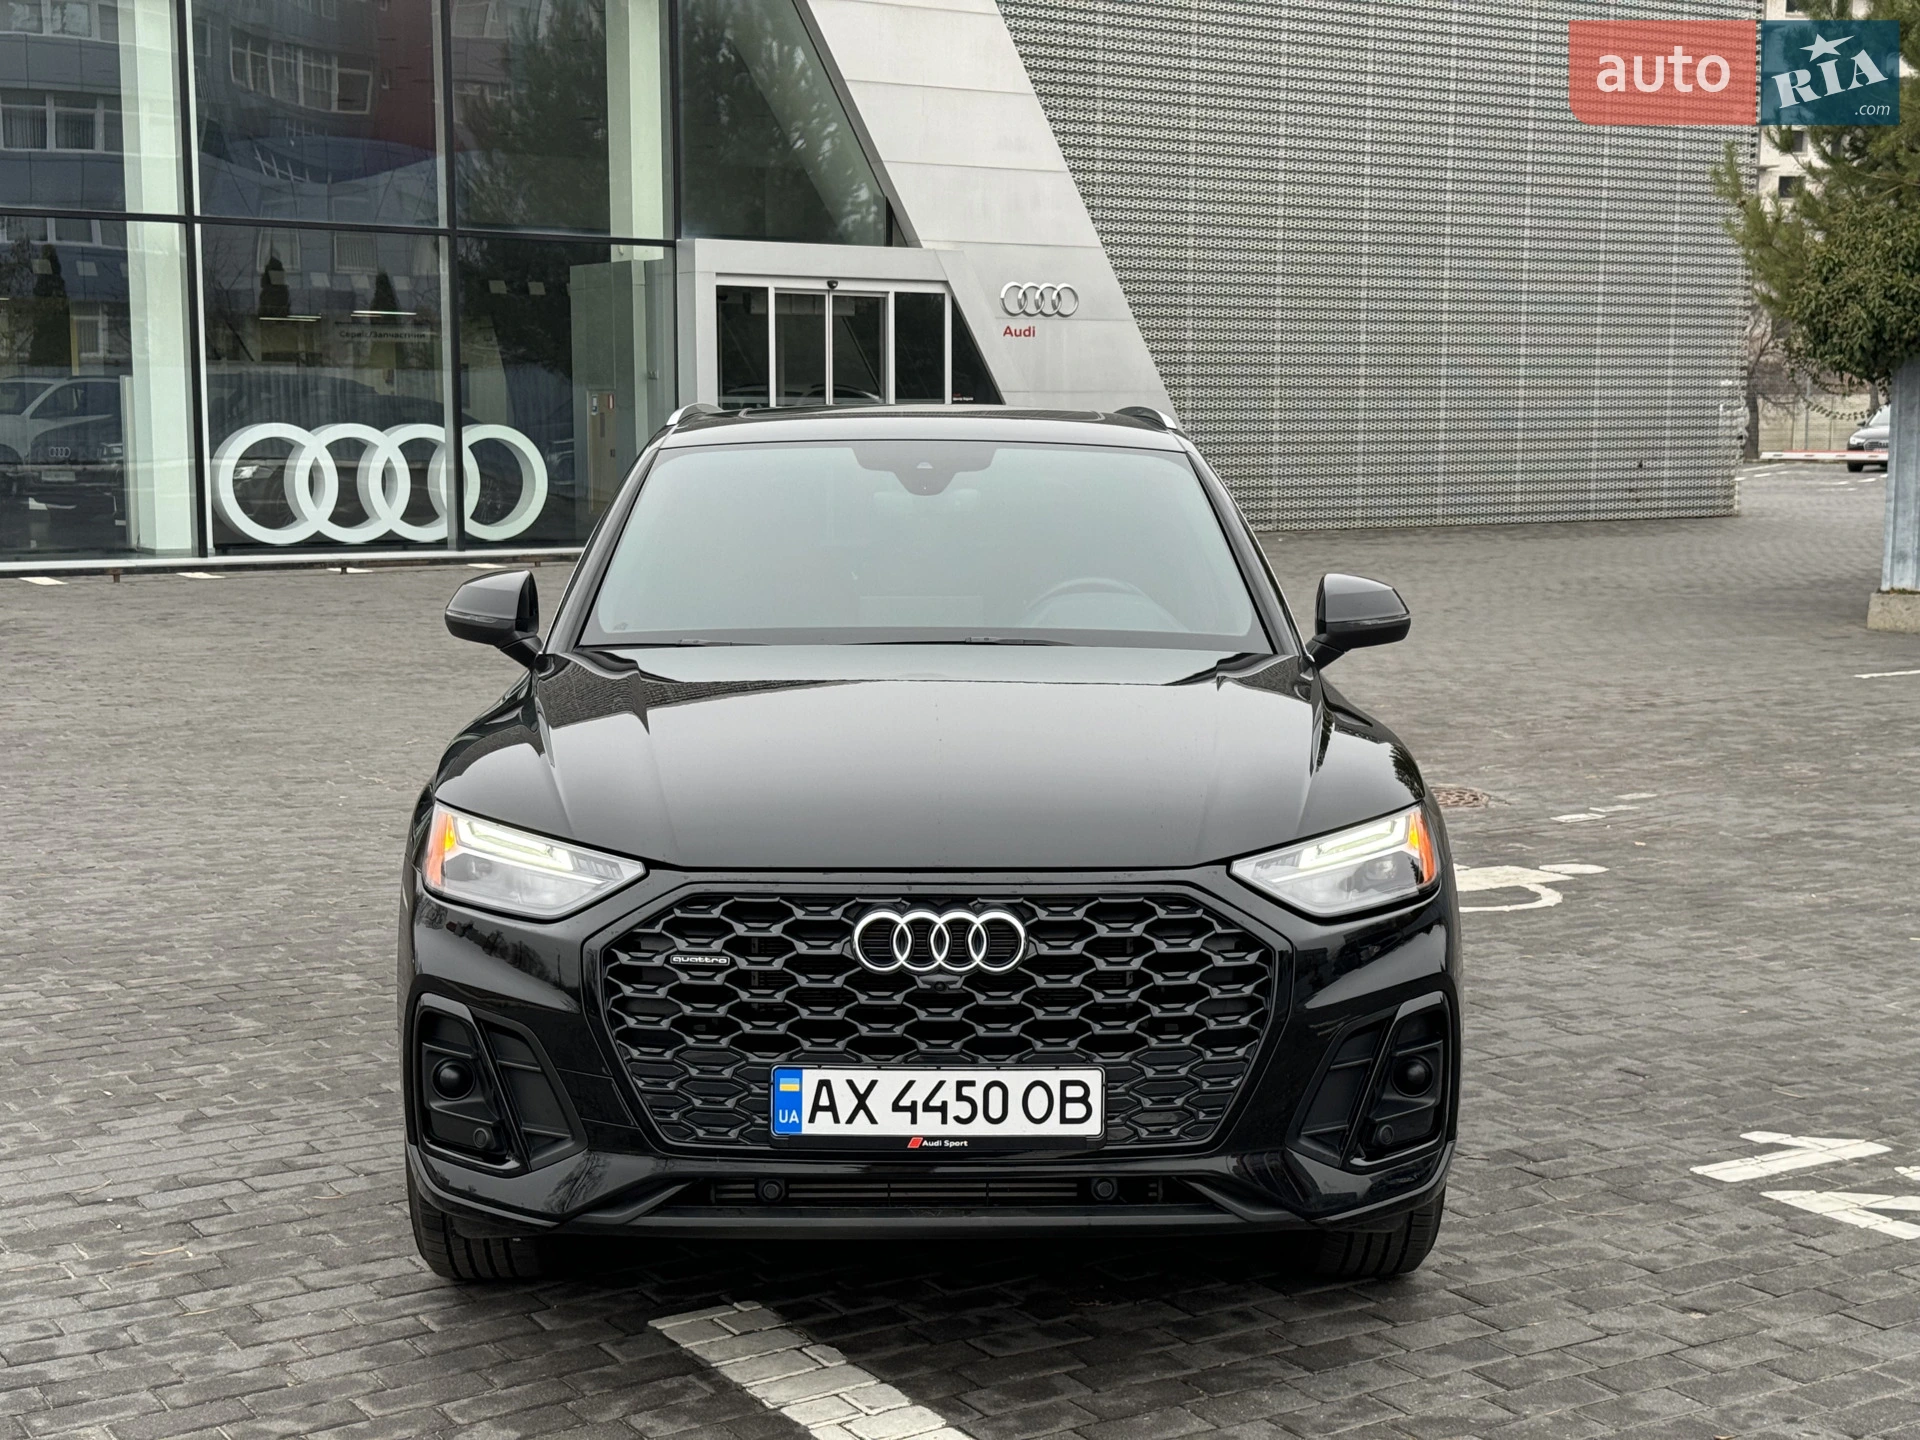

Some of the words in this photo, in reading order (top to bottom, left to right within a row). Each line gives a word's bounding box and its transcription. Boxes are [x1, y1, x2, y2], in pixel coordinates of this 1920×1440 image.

[1003, 325, 1036, 337] Audi
[672, 956, 727, 964] quattro
[807, 1078, 879, 1125] AX
[891, 1079, 1009, 1125] 4450
[1021, 1079, 1093, 1125] OB
[778, 1109, 799, 1124] UA
[943, 1139, 968, 1148] Sport
